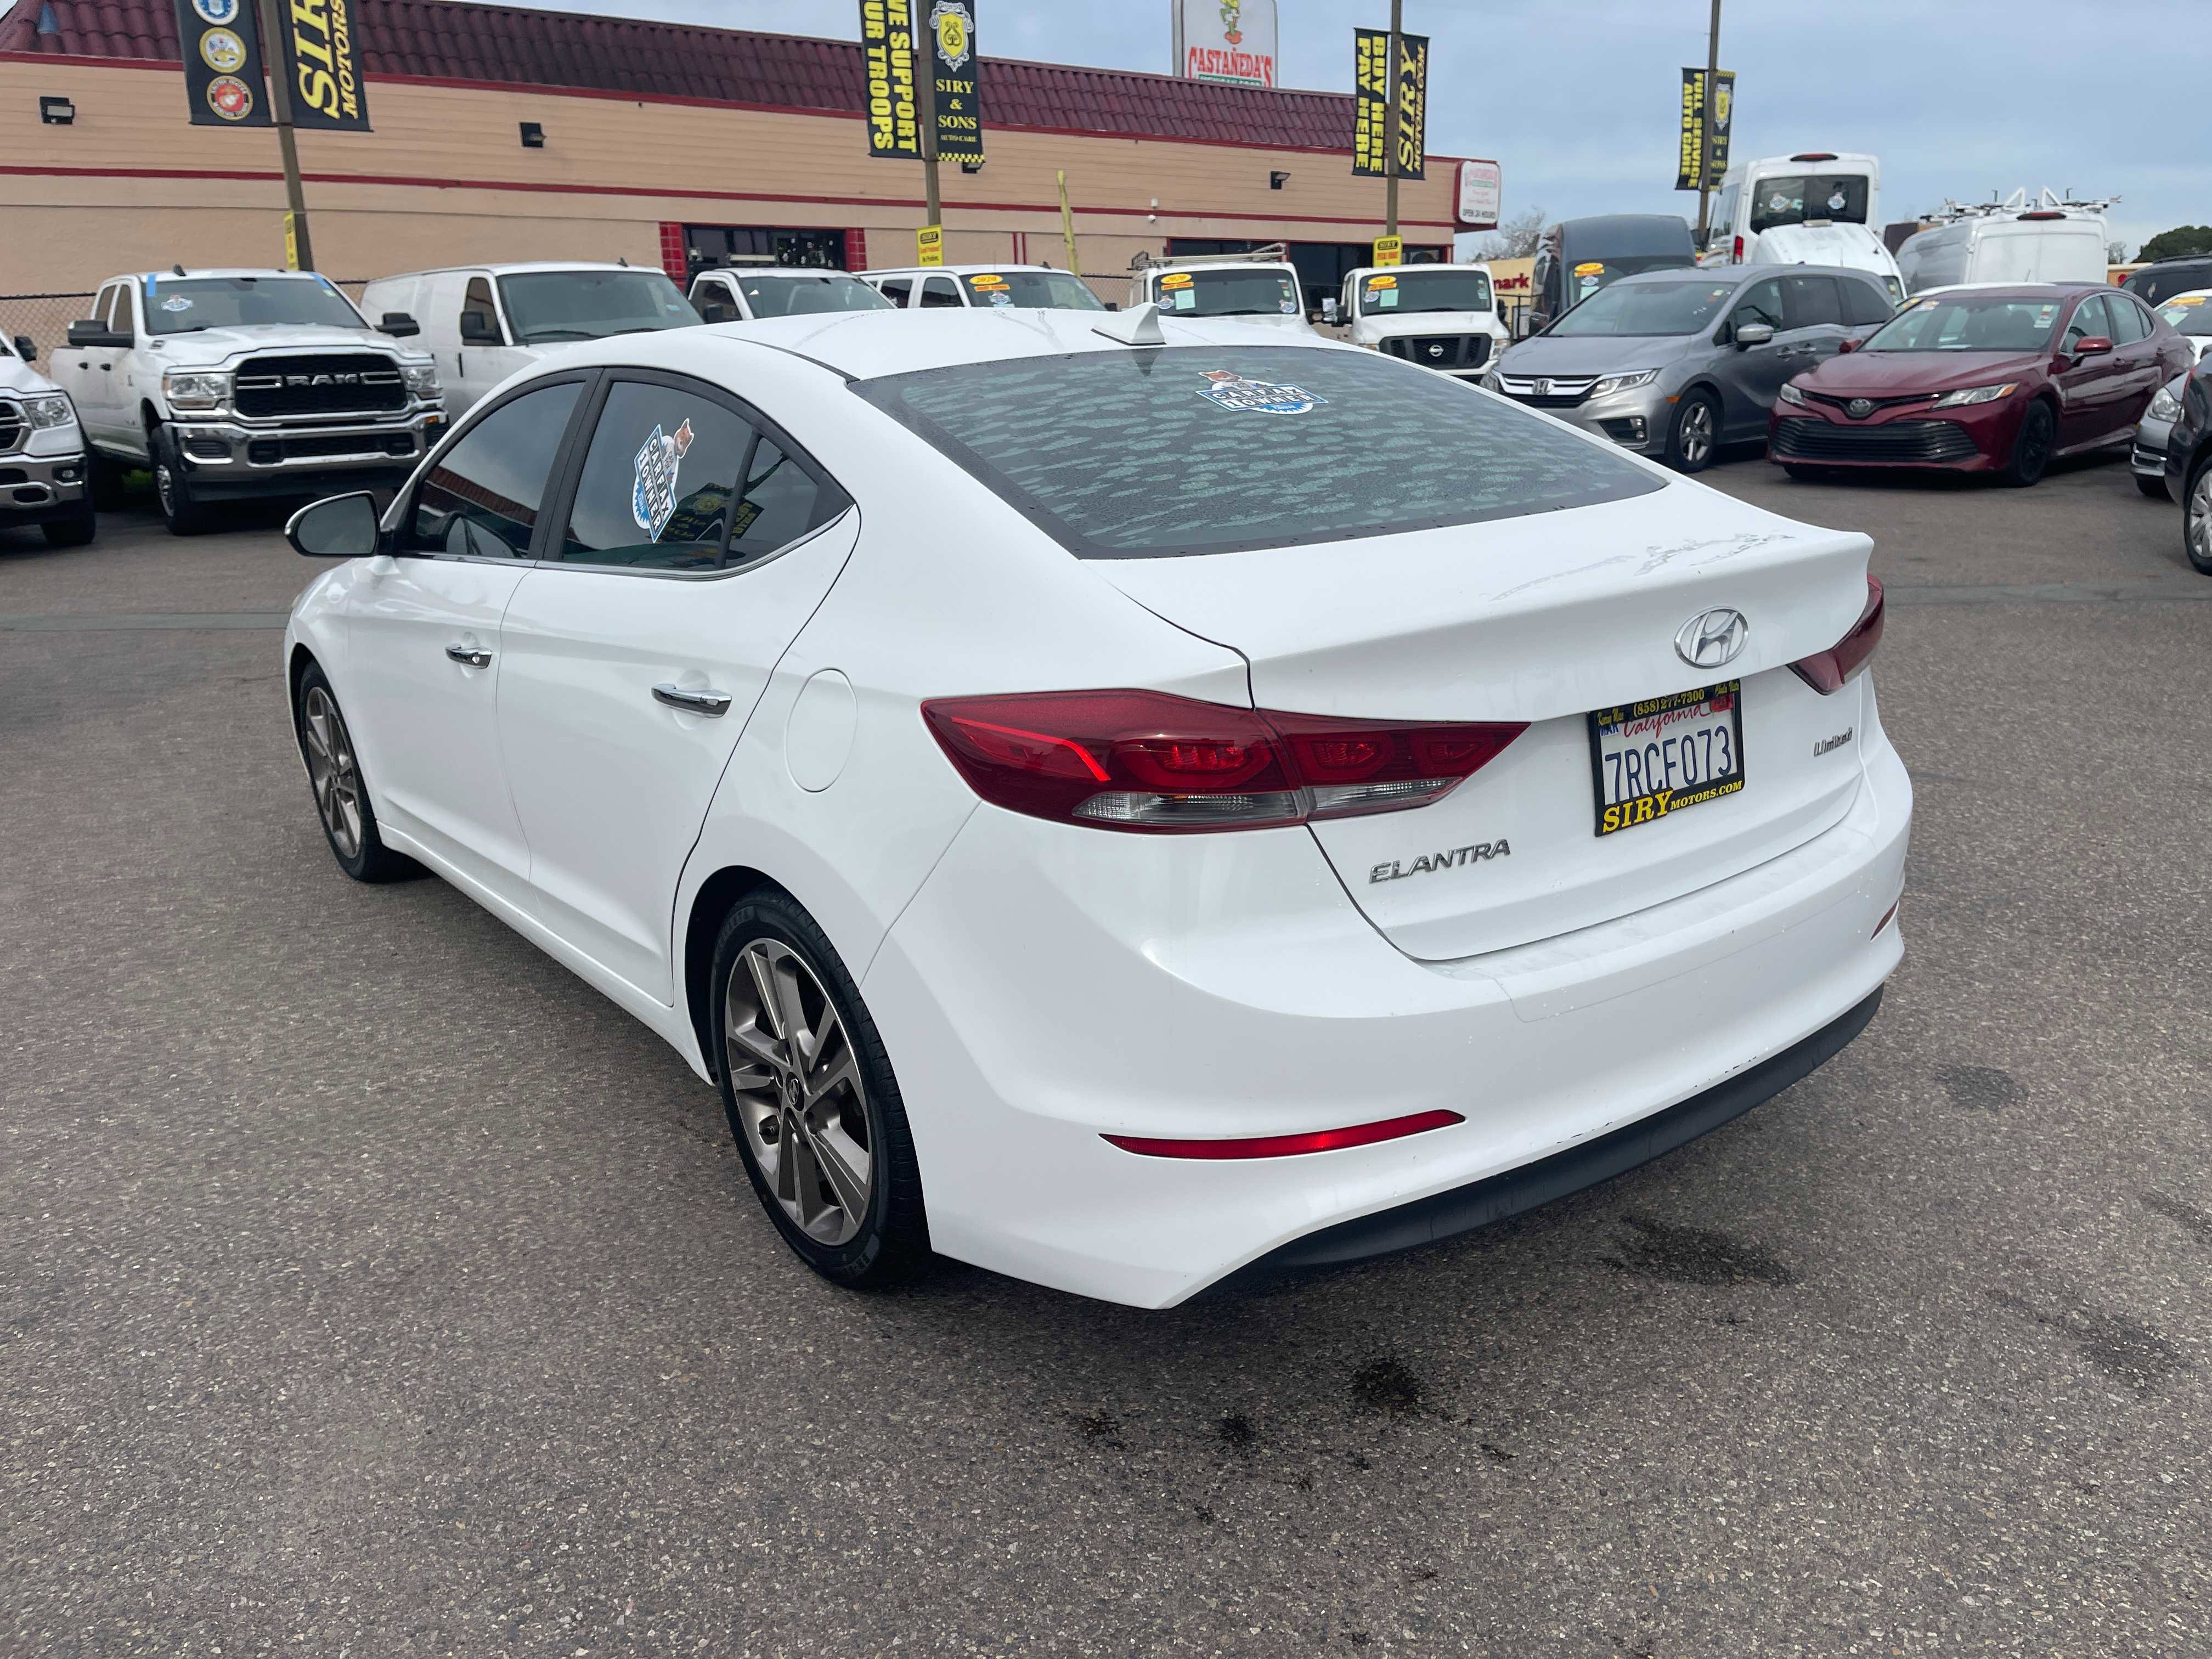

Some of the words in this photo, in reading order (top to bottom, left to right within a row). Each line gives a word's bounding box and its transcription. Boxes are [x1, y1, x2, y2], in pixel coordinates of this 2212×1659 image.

[864, 0, 885, 39] UR
[935, 79, 974, 94] SIRY
[1357, 37, 1372, 92] PAY
[1373, 36, 1386, 96] BUY
[867, 44, 894, 150] TROOPS
[889, 31, 917, 153] SUPPORT
[949, 99, 963, 110] &
[1397, 40, 1417, 173] SIRY
[938, 115, 978, 130] SONS
[1355, 97, 1370, 168] HERE
[1369, 102, 1385, 172] HERE
[286, 374, 357, 386] RAM
[1211, 389, 1304, 399] CARFAX
[648, 438, 670, 518] CARFAX
[1624, 703, 1711, 738] California
[1633, 699, 1659, 718] (858)
[1605, 725, 1731, 804] 7RCF073
[1814, 726, 1853, 757] Limited
[1602, 790, 1673, 833] SIRY
[1670, 780, 1743, 810] MOTORS.COM
[1369, 838, 1510, 884] ELANTRA
